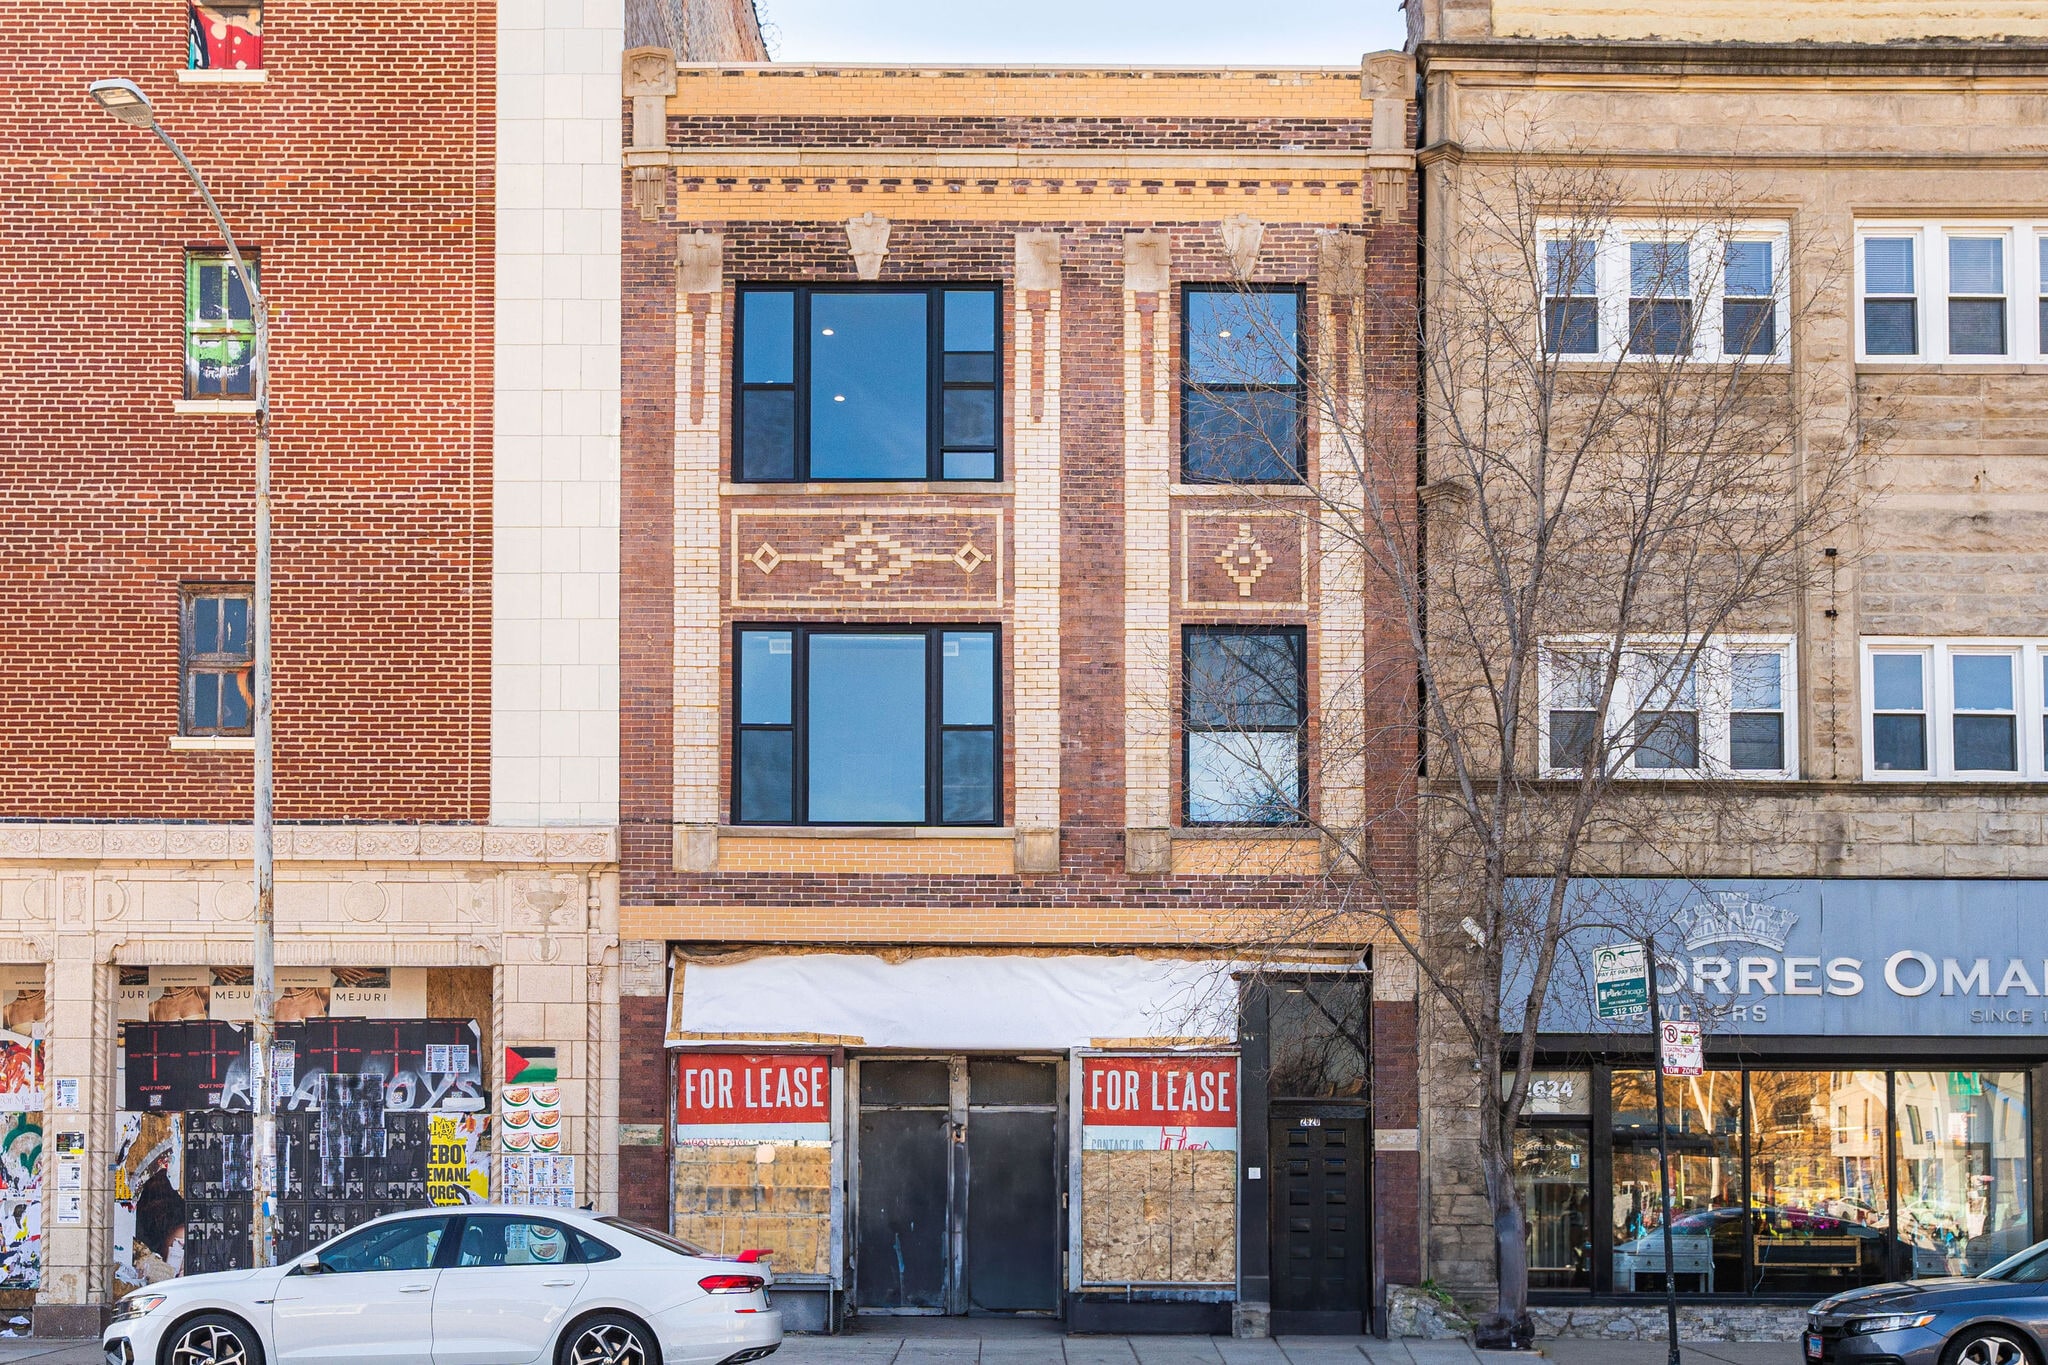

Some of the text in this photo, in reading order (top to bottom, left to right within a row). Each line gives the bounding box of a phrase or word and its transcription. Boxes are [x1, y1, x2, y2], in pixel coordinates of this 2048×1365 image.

[1654, 955, 1865, 997] ORRES
[215, 991, 250, 1000] MEJU
[336, 993, 387, 1002] MEJURI
[1612, 1007, 1627, 1016] 312
[1629, 1005, 1643, 1013] 109
[1613, 1005, 1767, 1022] WEERS
[1971, 1009, 2033, 1024] SINCE
[1682, 1067, 1700, 1075] ZONE
[685, 1067, 824, 1109] FOR LEASE
[1092, 1070, 1230, 1112] FOR LEASE
[1091, 1138, 1144, 1150] CONTACT US
